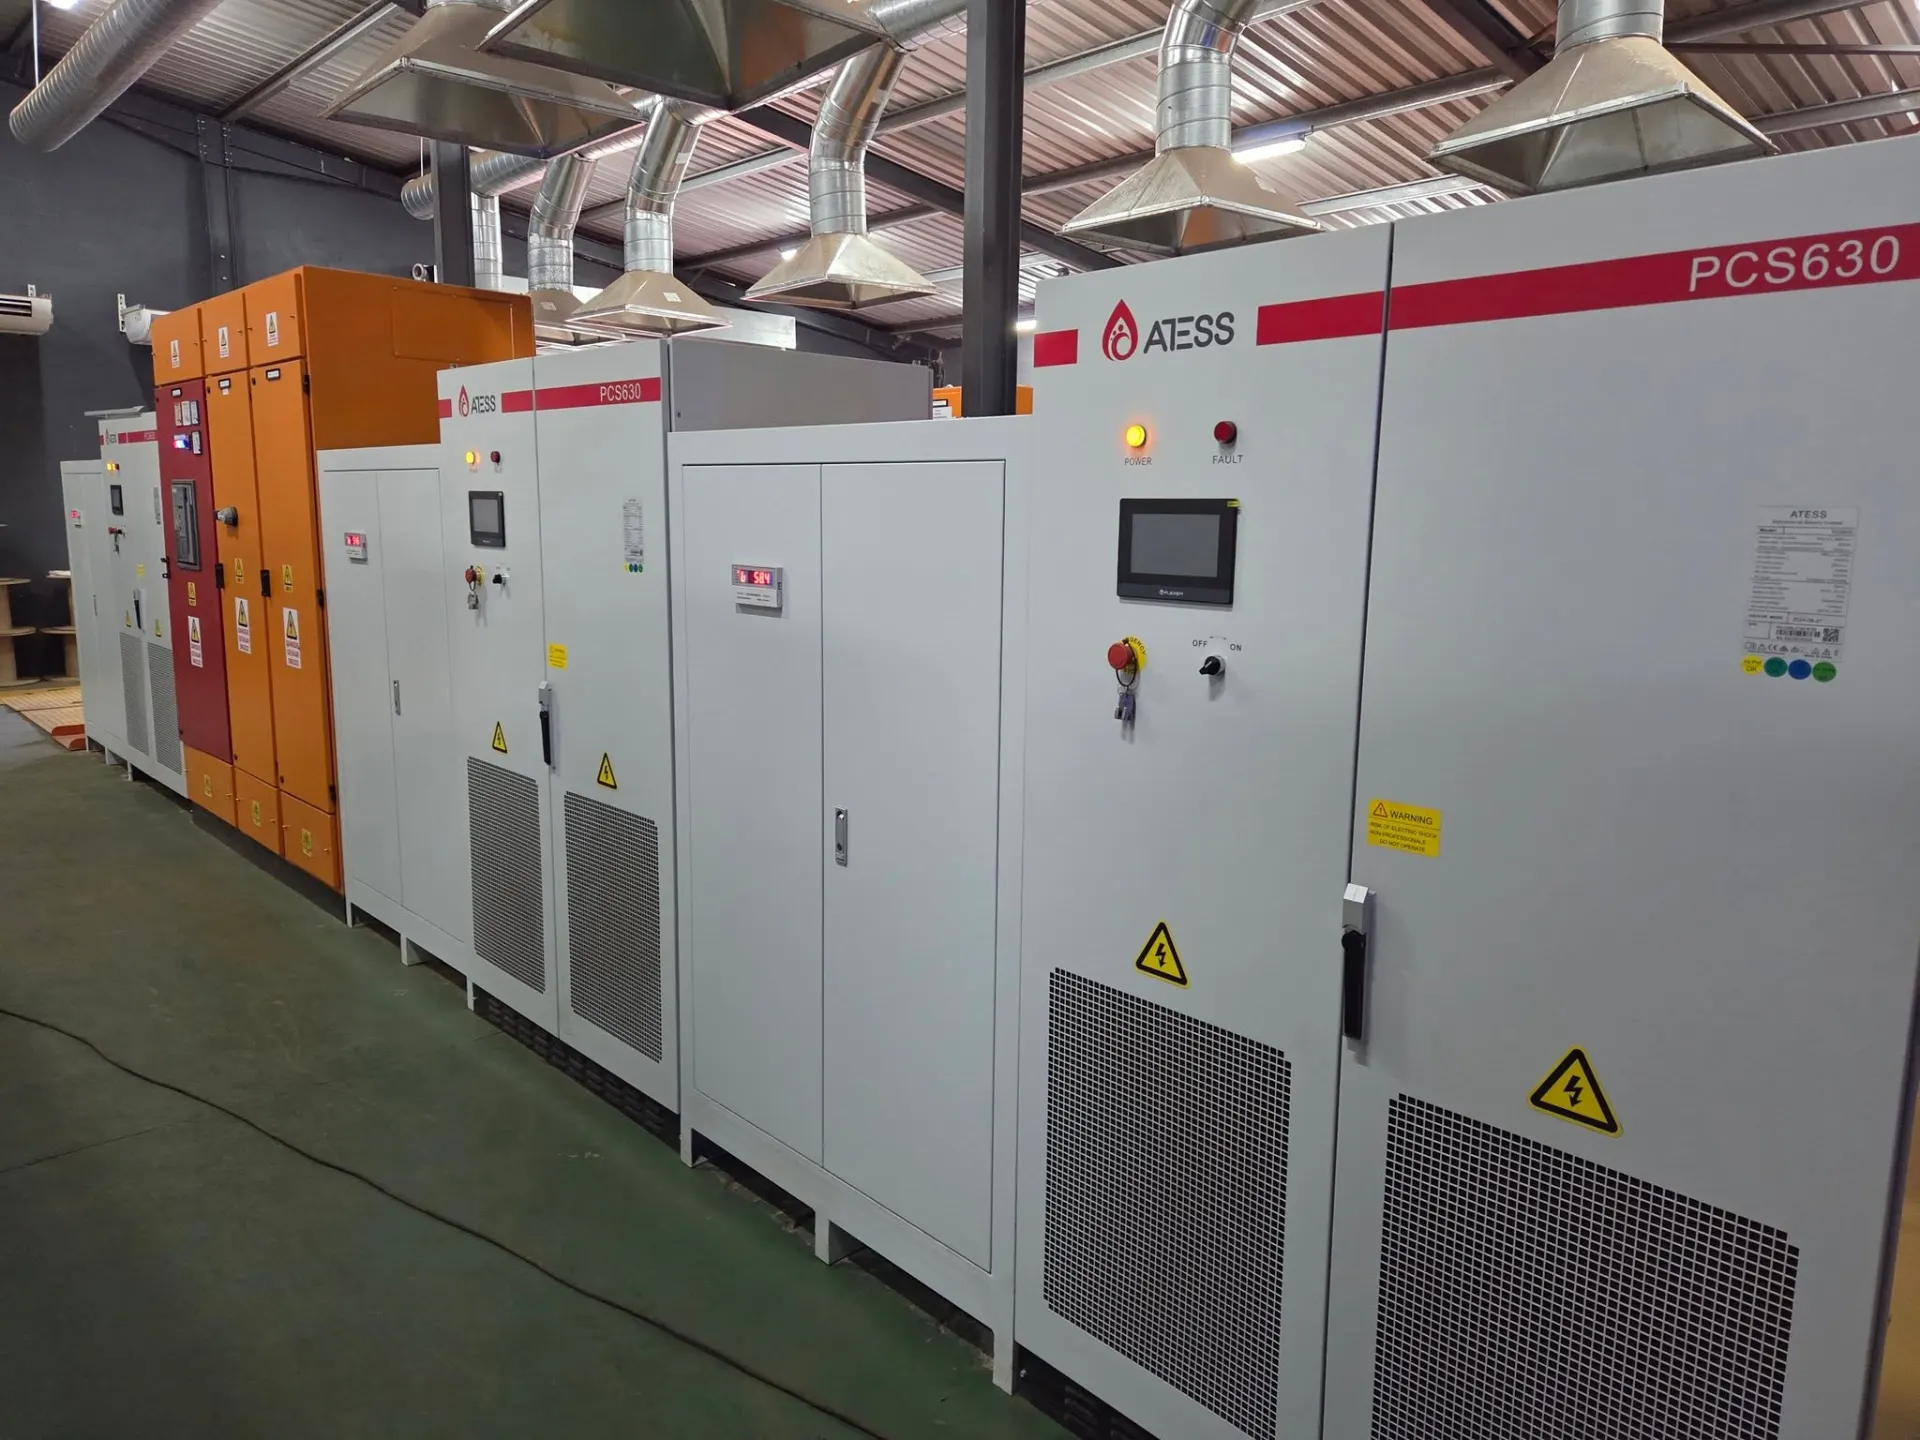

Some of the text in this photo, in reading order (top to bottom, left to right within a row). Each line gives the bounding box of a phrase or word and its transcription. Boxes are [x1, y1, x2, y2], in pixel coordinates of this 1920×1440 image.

[1689, 235, 1900, 292] PCS630
[1143, 311, 1235, 354] ATESS
[600, 383, 642, 402] PCS630
[471, 395, 496, 414] ATESS
[1124, 457, 1152, 466] POWER
[1212, 454, 1243, 464] FAULT
[1790, 510, 1827, 519] ATESS
[1192, 639, 1208, 648] OFF
[1229, 643, 1242, 651] ON
[1390, 810, 1433, 825] WARNING
[1391, 826, 1417, 835] ELECTRIC
[1419, 831, 1437, 839] SHOCK
[1401, 844, 1425, 853] OPERATE
